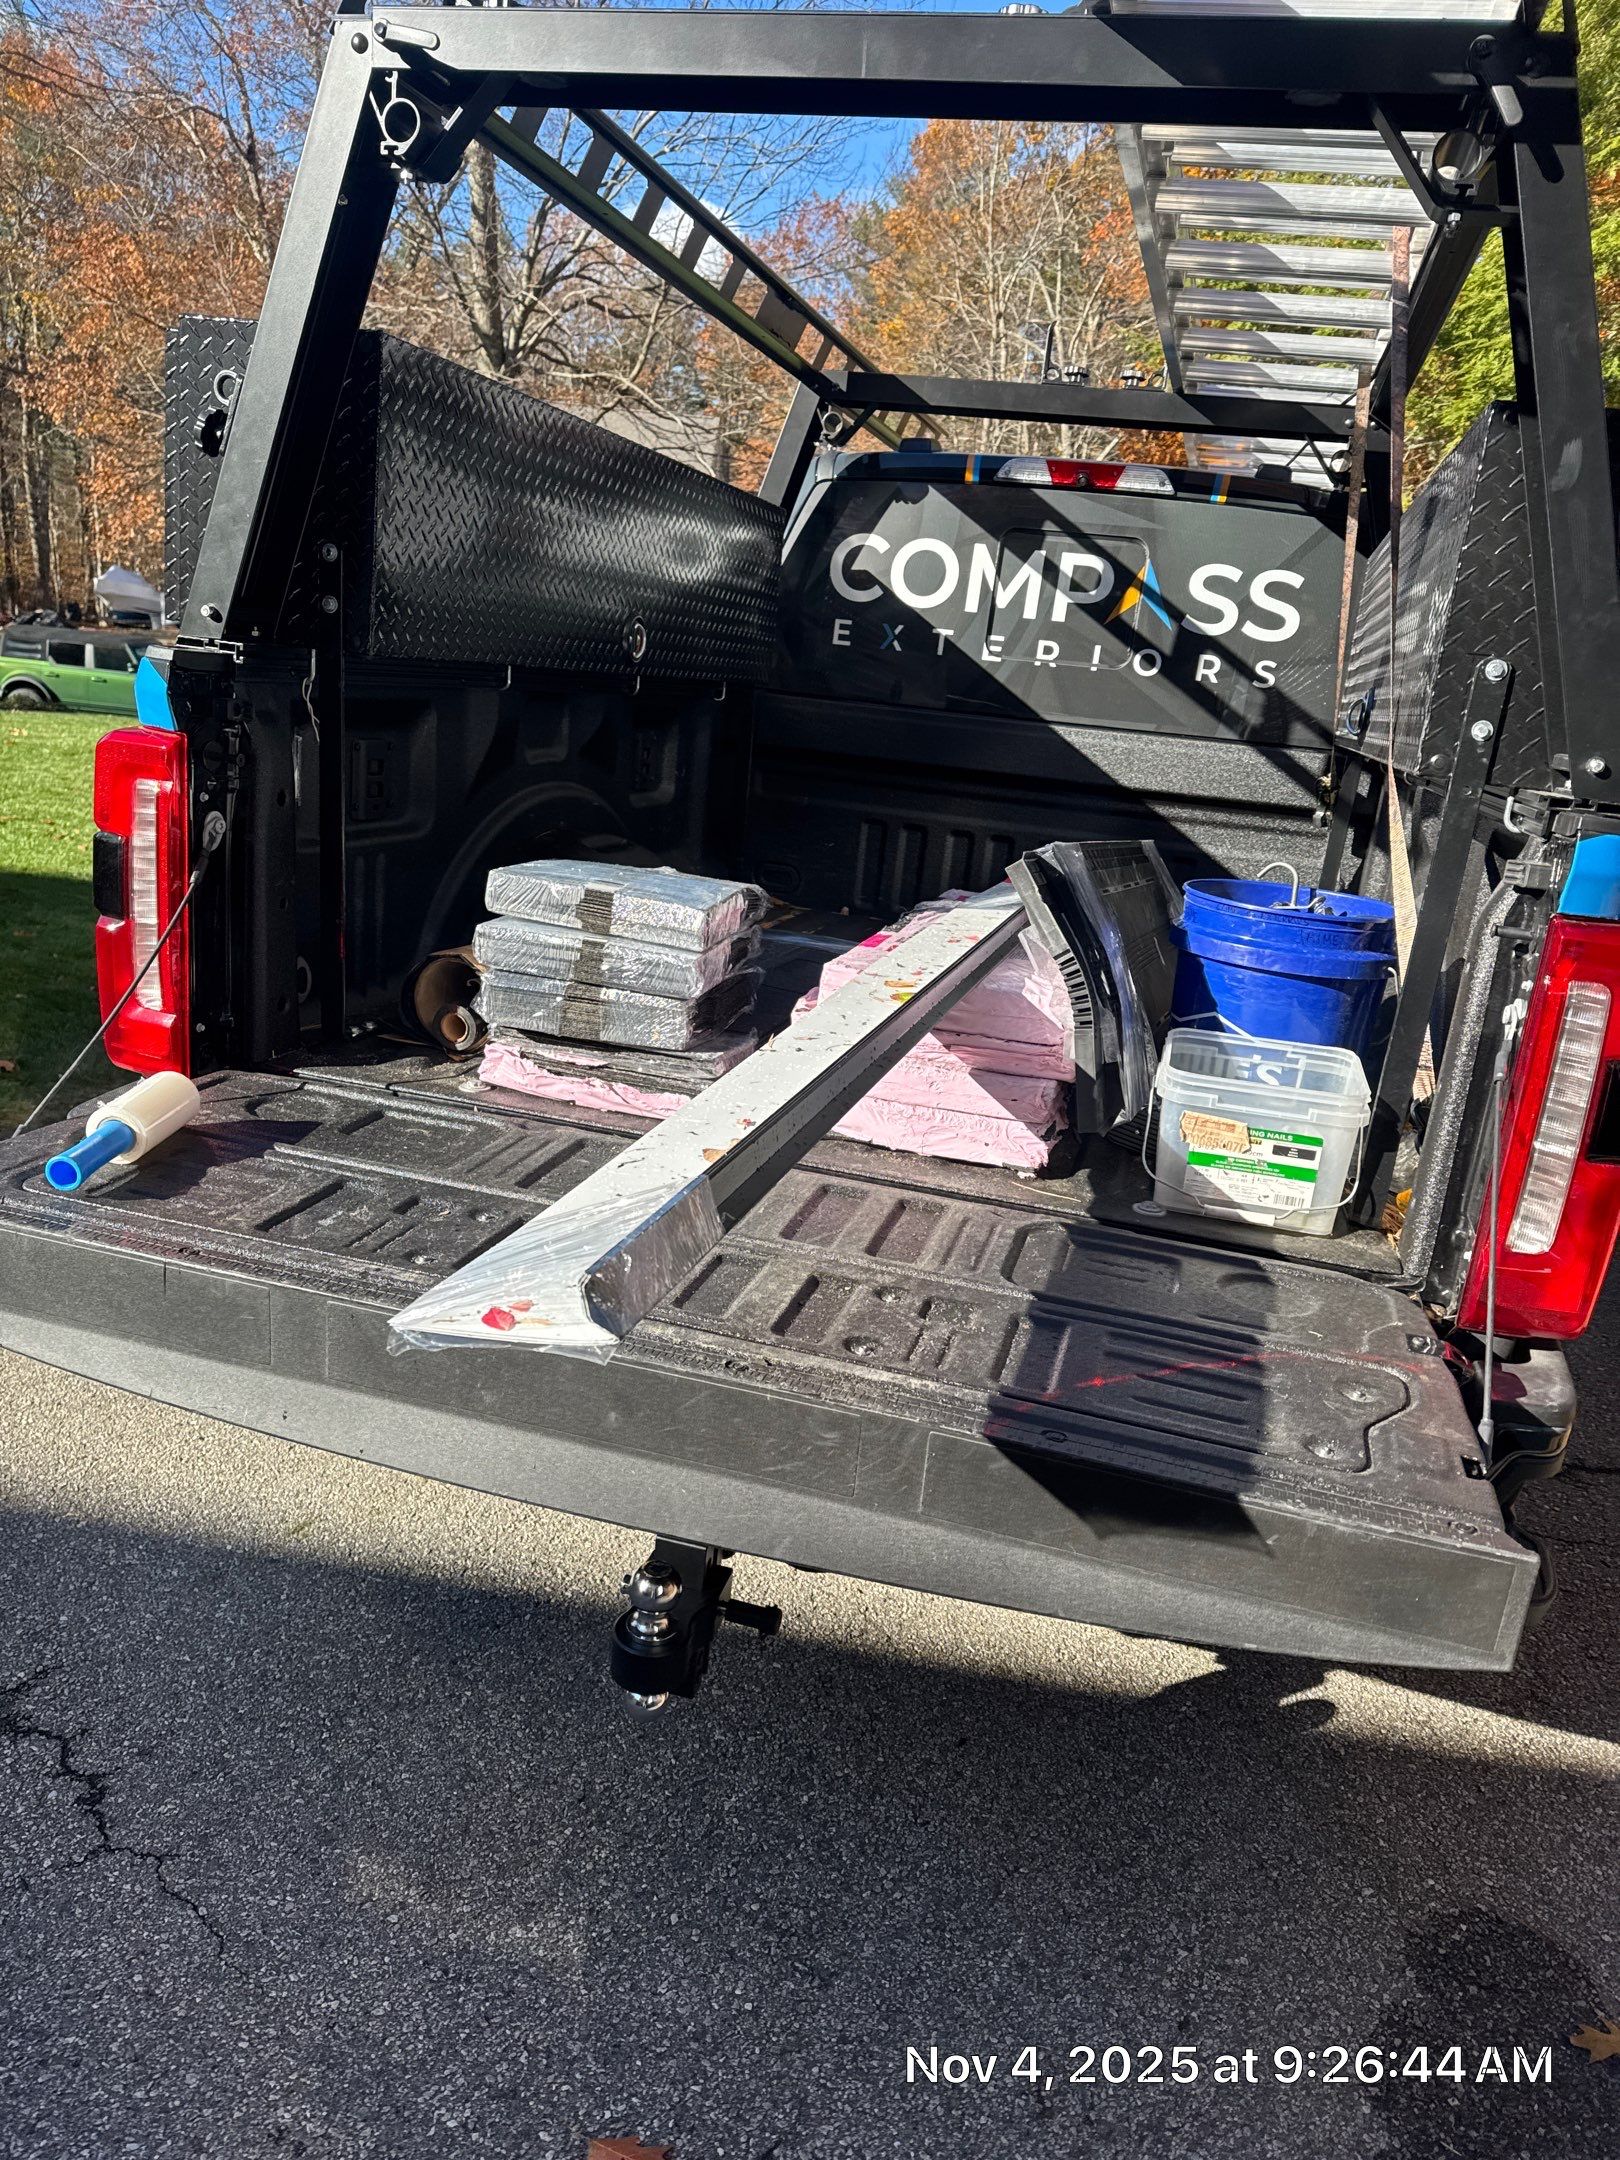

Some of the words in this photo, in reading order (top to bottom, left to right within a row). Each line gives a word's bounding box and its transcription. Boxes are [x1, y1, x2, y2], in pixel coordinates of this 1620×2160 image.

[829, 532, 1305, 643] COMPASS
[831, 617, 1278, 689] EXTERIORS
[1266, 1131, 1293, 1142] NAILS
